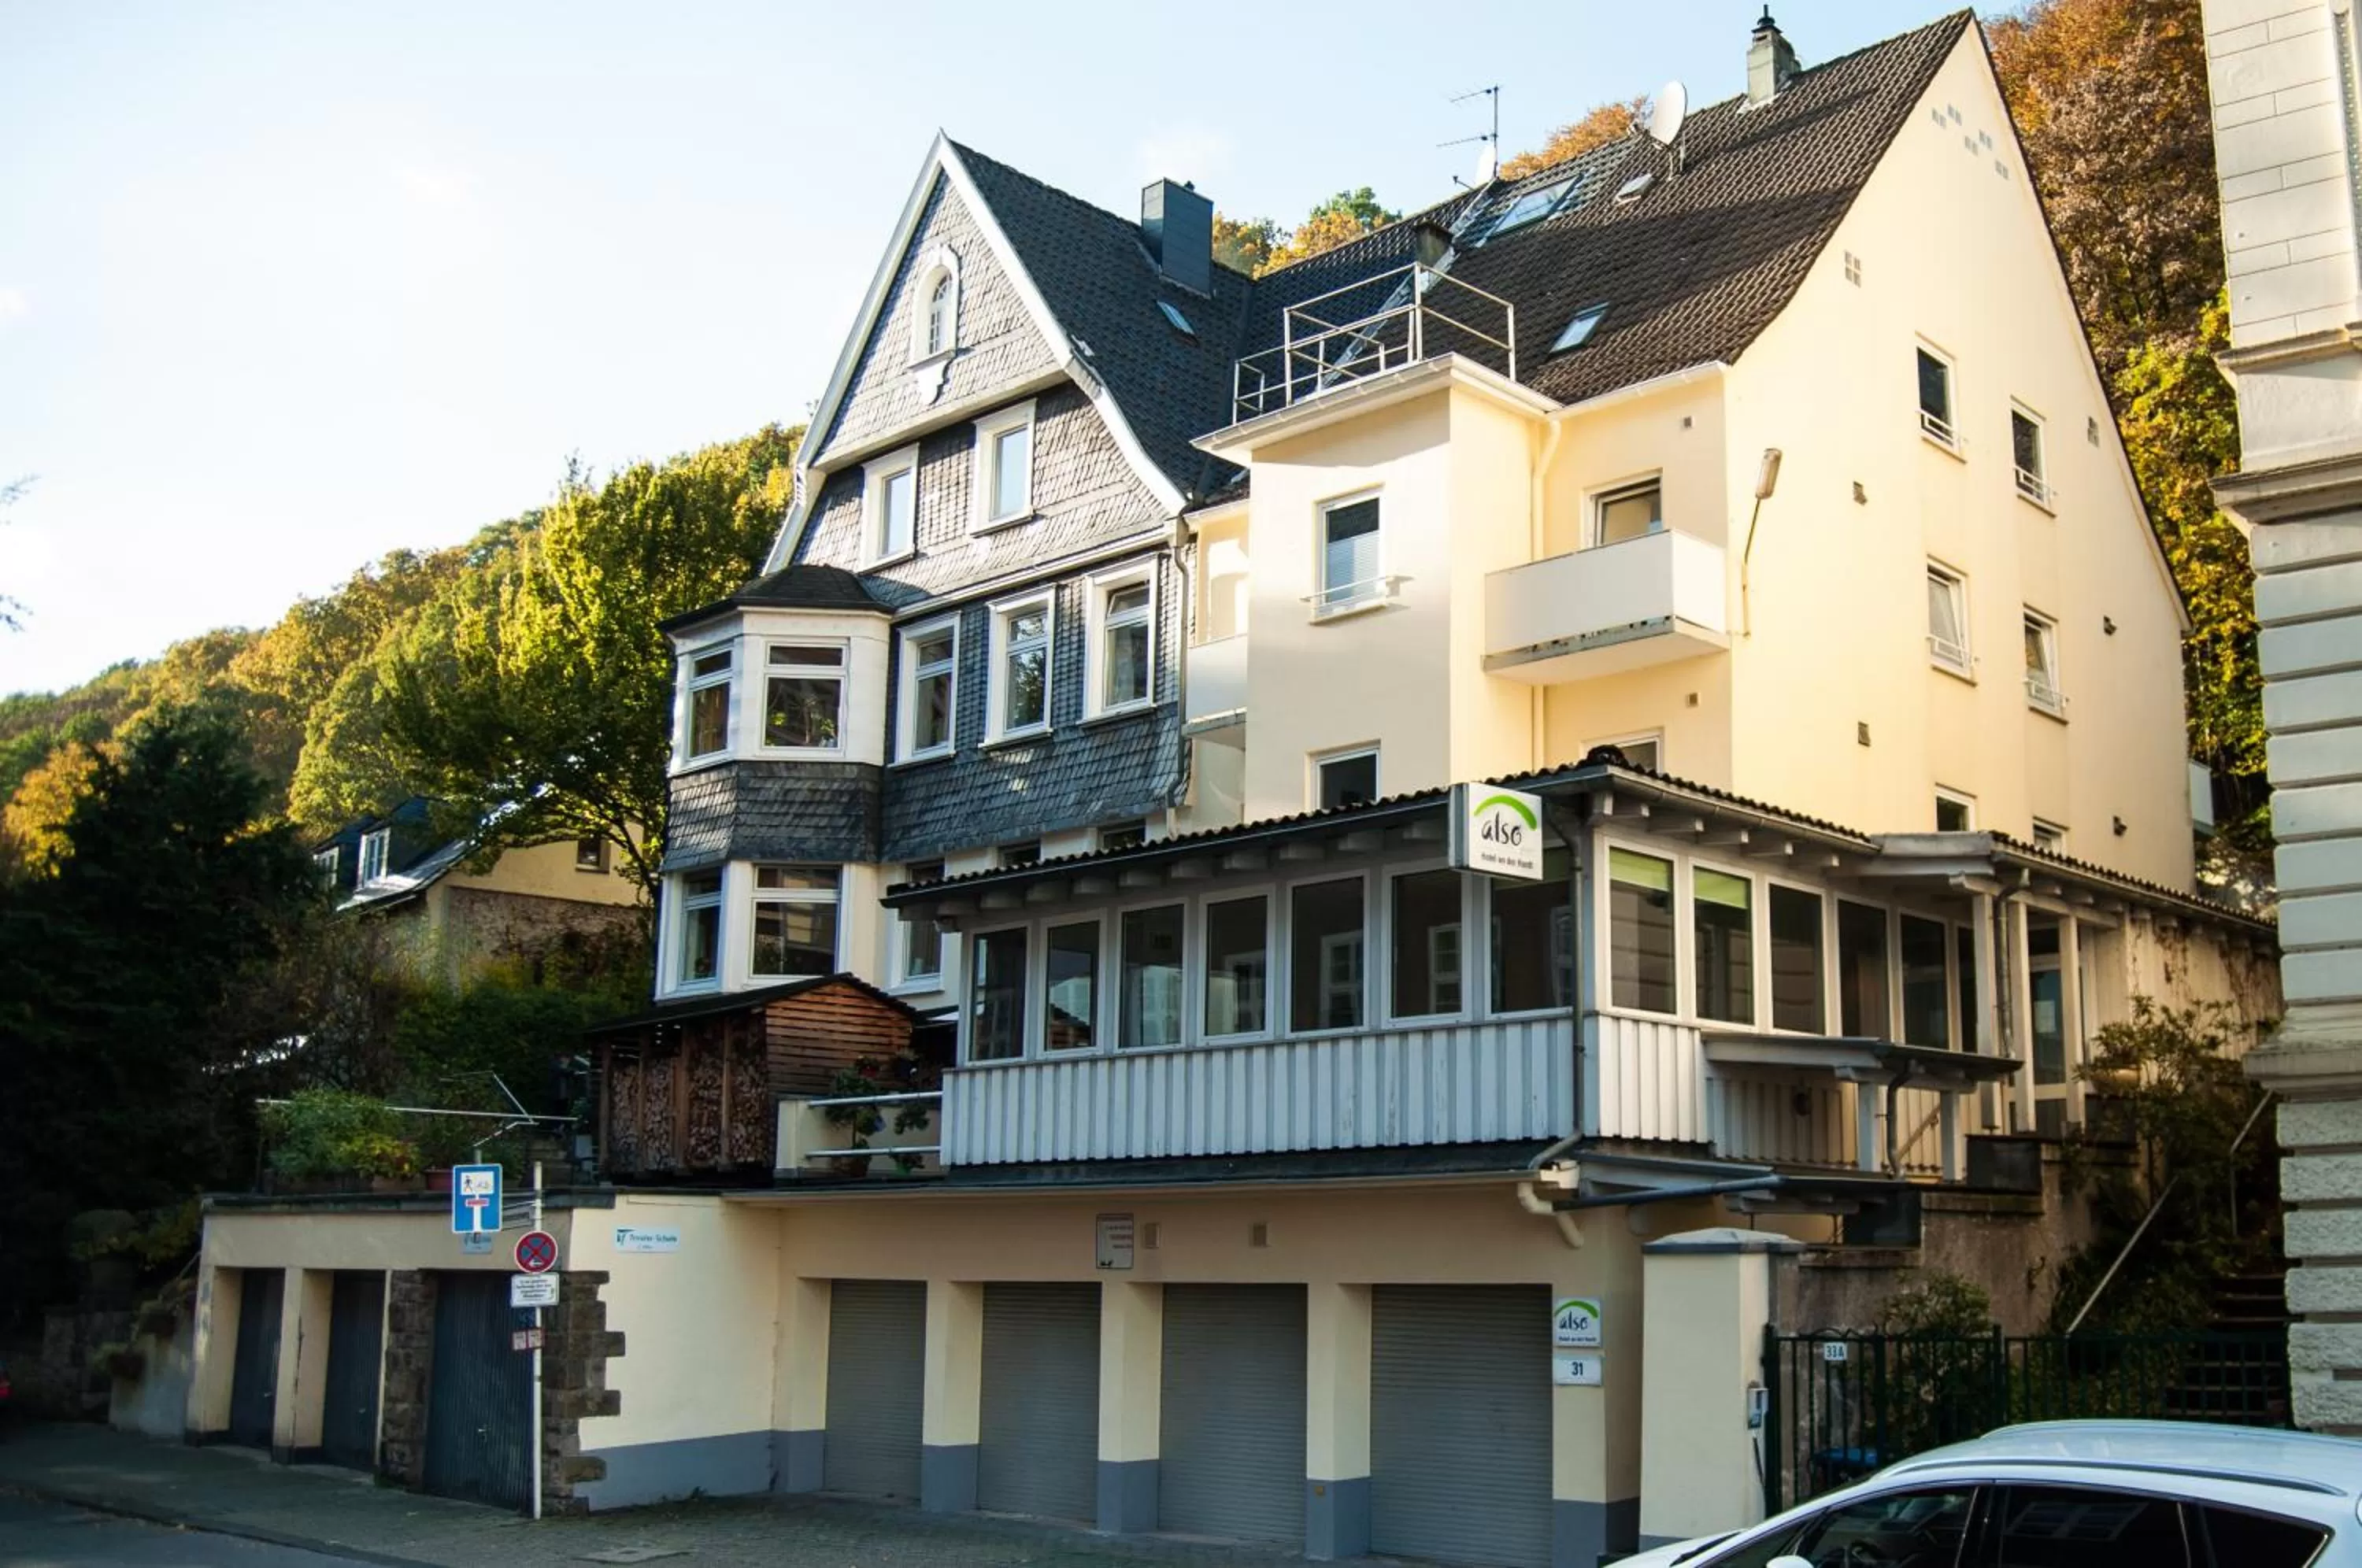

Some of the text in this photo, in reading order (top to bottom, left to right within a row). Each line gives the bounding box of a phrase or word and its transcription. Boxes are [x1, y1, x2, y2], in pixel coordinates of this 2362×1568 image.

[1481, 811, 1521, 846] also
[1559, 1310, 1587, 1330] also
[1572, 1362, 1583, 1376] 31
